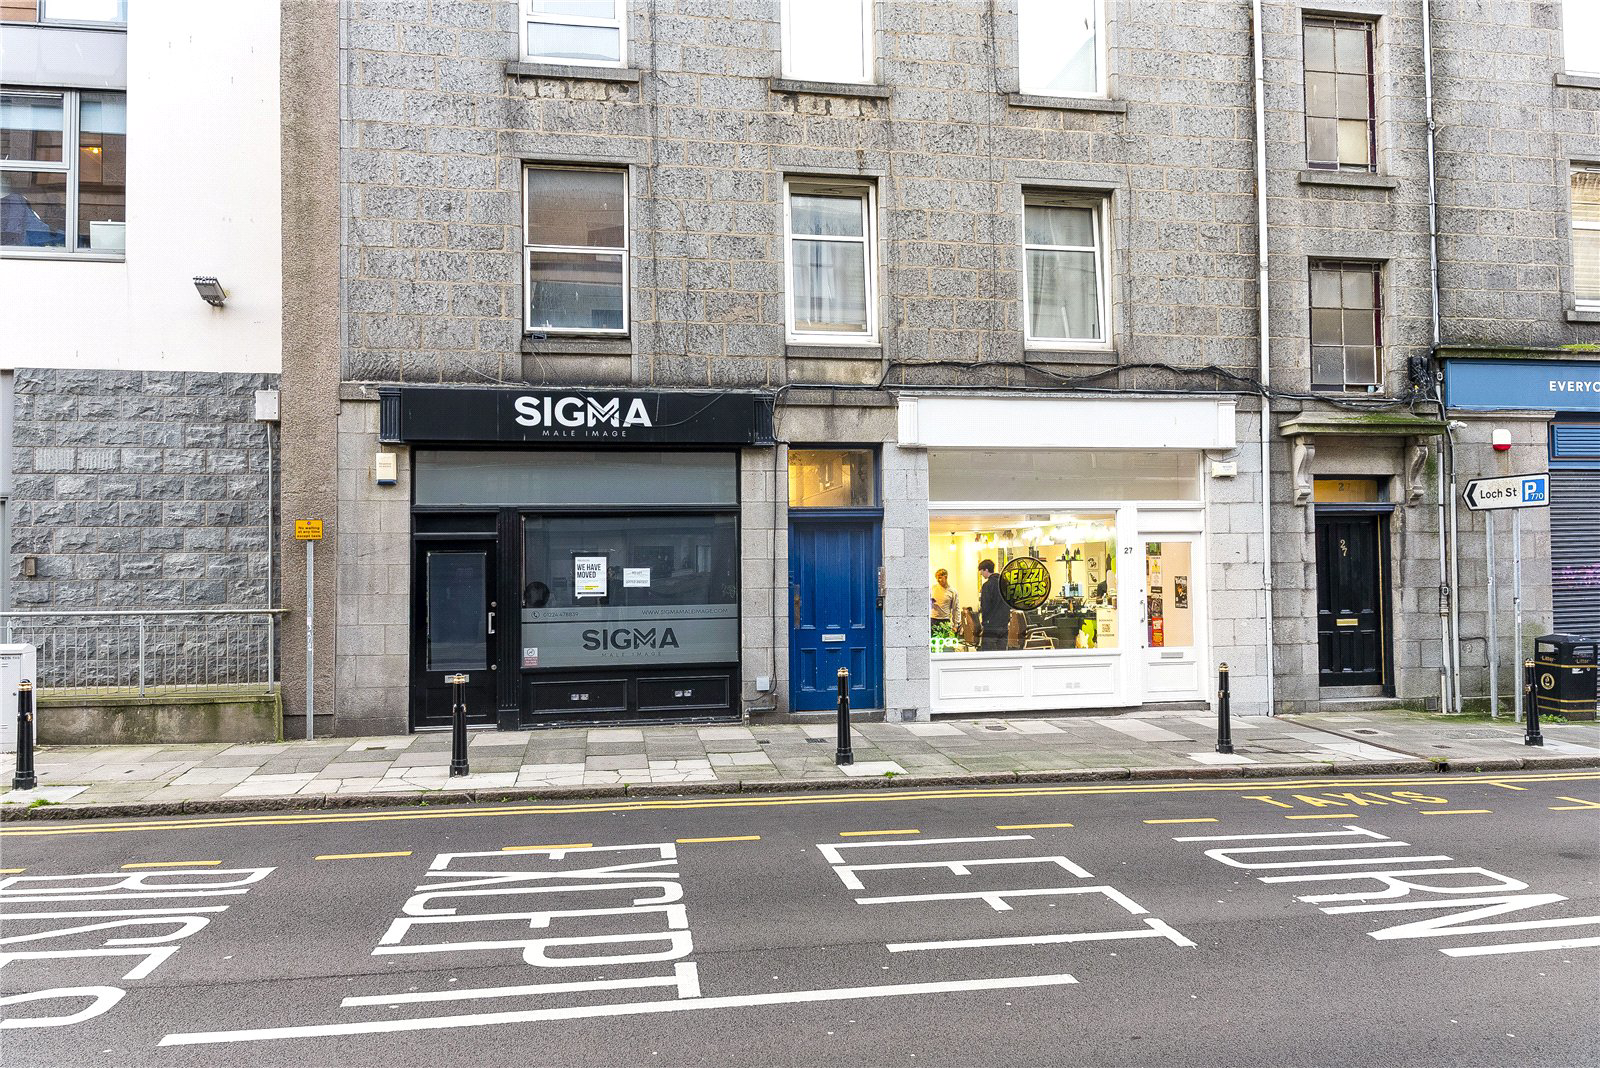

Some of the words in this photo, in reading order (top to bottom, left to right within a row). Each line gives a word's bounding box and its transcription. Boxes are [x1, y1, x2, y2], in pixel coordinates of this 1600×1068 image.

[514, 395, 653, 428] SIGMA
[542, 429, 576, 437] MALE
[585, 430, 627, 438] IMAGE
[1480, 488, 1503, 499] Loch
[1505, 487, 1517, 497] St
[1524, 481, 1537, 501] P
[1124, 546, 1133, 555] 27
[1339, 538, 1349, 557] 27
[577, 563, 586, 571] WE
[586, 563, 602, 571] HAVE
[577, 571, 597, 579] MOVED
[1006, 582, 1047, 601] FADES
[582, 627, 680, 651] SIGMA
[1241, 790, 1448, 808] TAXIS
[816, 835, 1197, 952] LEFT
[1171, 825, 1600, 957] TURN
[340, 842, 702, 1007] EXCEPT
